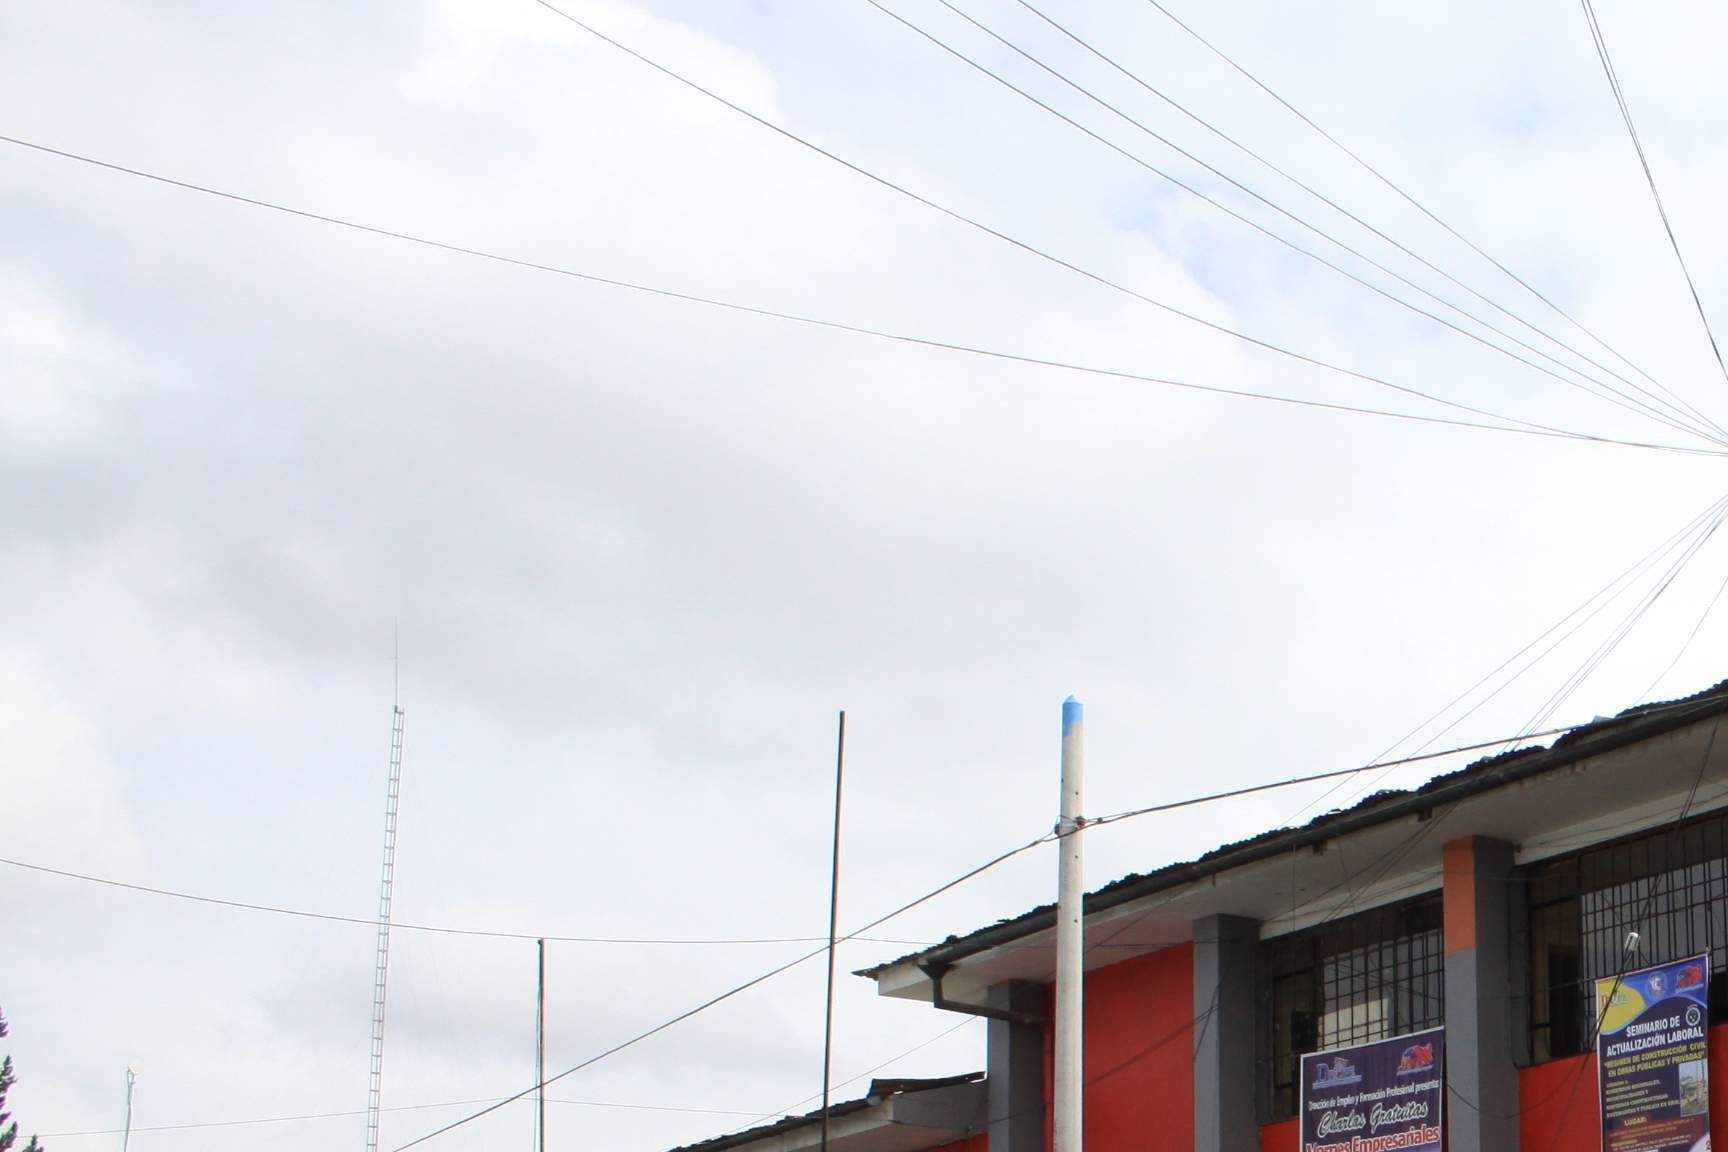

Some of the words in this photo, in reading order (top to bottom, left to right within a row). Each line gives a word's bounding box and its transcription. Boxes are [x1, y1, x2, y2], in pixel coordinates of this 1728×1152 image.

[1626, 1019, 1668, 1037] SEMINARIO
[1669, 1015, 1680, 1029] DE
[1606, 1034, 1665, 1057] ACTUALIZACIÓN
[1667, 1027, 1704, 1045] LABORAL
[1317, 1109, 1366, 1138] Charlas
[1369, 1100, 1429, 1134] Gratuitas
